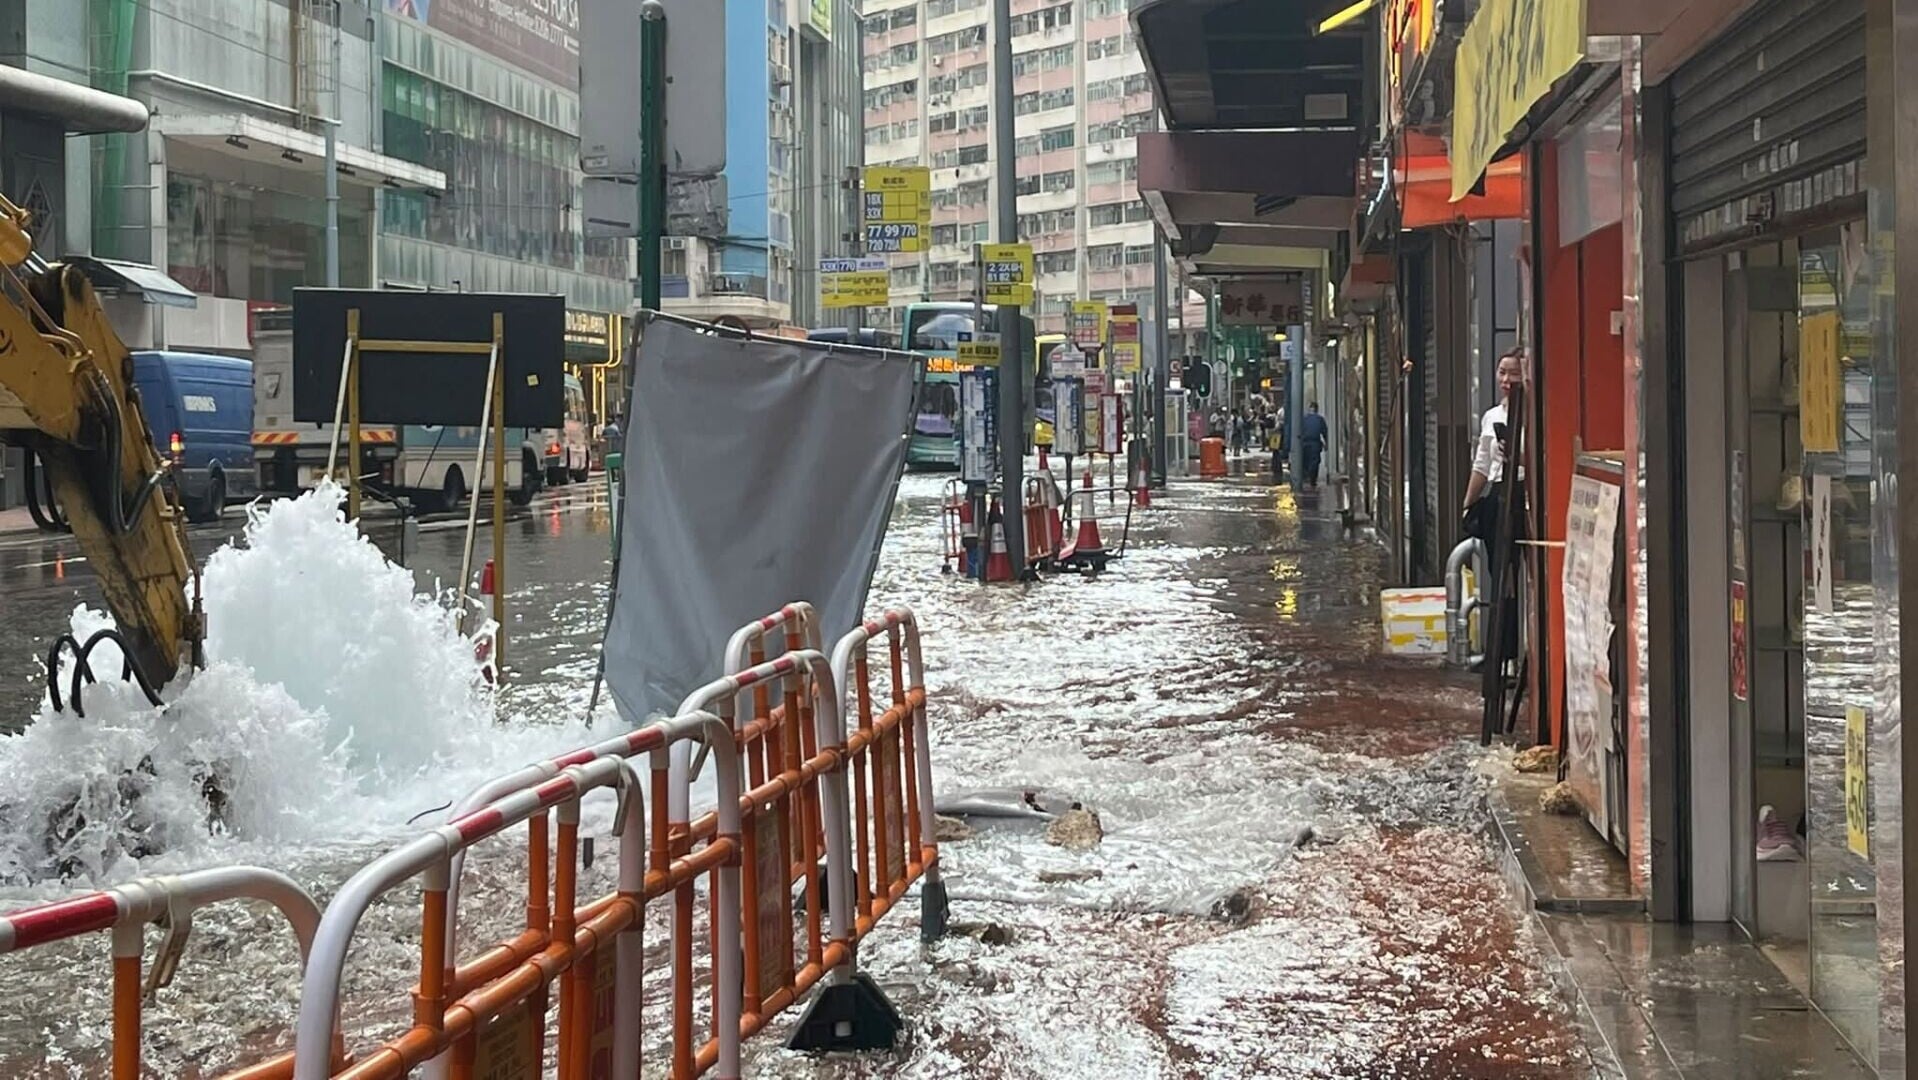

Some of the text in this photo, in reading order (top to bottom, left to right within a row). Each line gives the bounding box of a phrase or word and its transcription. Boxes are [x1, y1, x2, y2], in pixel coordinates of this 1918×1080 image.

[867, 224, 917, 238] 77 99 770
[868, 239, 884, 252] 720
[839, 260, 856, 272] 770
[988, 262, 996, 272] 2
[998, 262, 1011, 272] 2X
